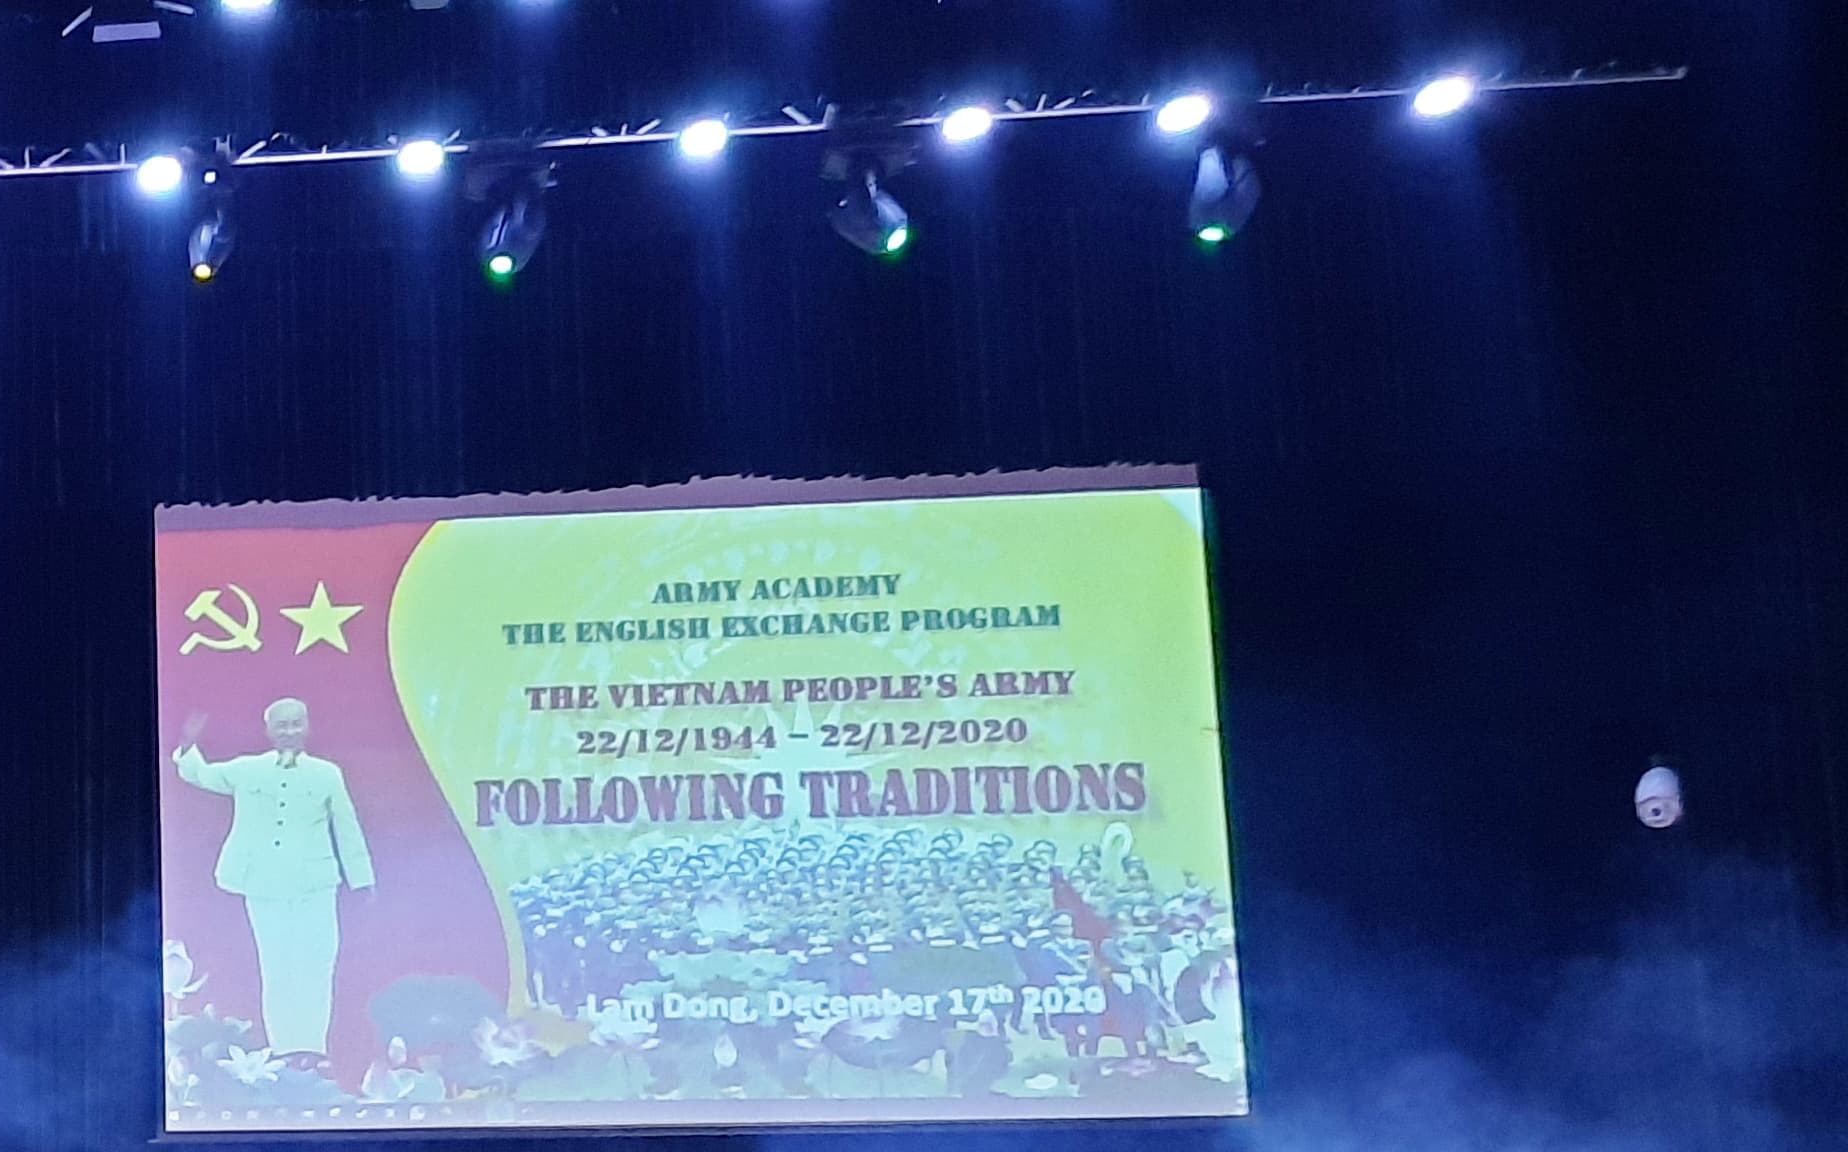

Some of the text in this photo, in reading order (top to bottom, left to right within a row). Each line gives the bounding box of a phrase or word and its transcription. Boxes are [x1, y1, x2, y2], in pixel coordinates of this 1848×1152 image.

[650, 573, 901, 604] ARMY ACADEMY
[502, 604, 1061, 645] THE ENGLISH EXCHANGE PROGRAM
[524, 684, 599, 711] THE
[608, 680, 772, 709] VIETNAM
[969, 669, 1076, 697] ARMY
[577, 725, 777, 758] 22/12/1944
[820, 717, 1028, 751] 22/12/2020
[473, 761, 1147, 827] FOLLOWING TRADITIONS
[586, 992, 654, 1022] Lam
[768, 987, 940, 1020] December
[948, 983, 1014, 1016] 17th
[1020, 984, 1107, 1015] 2020
